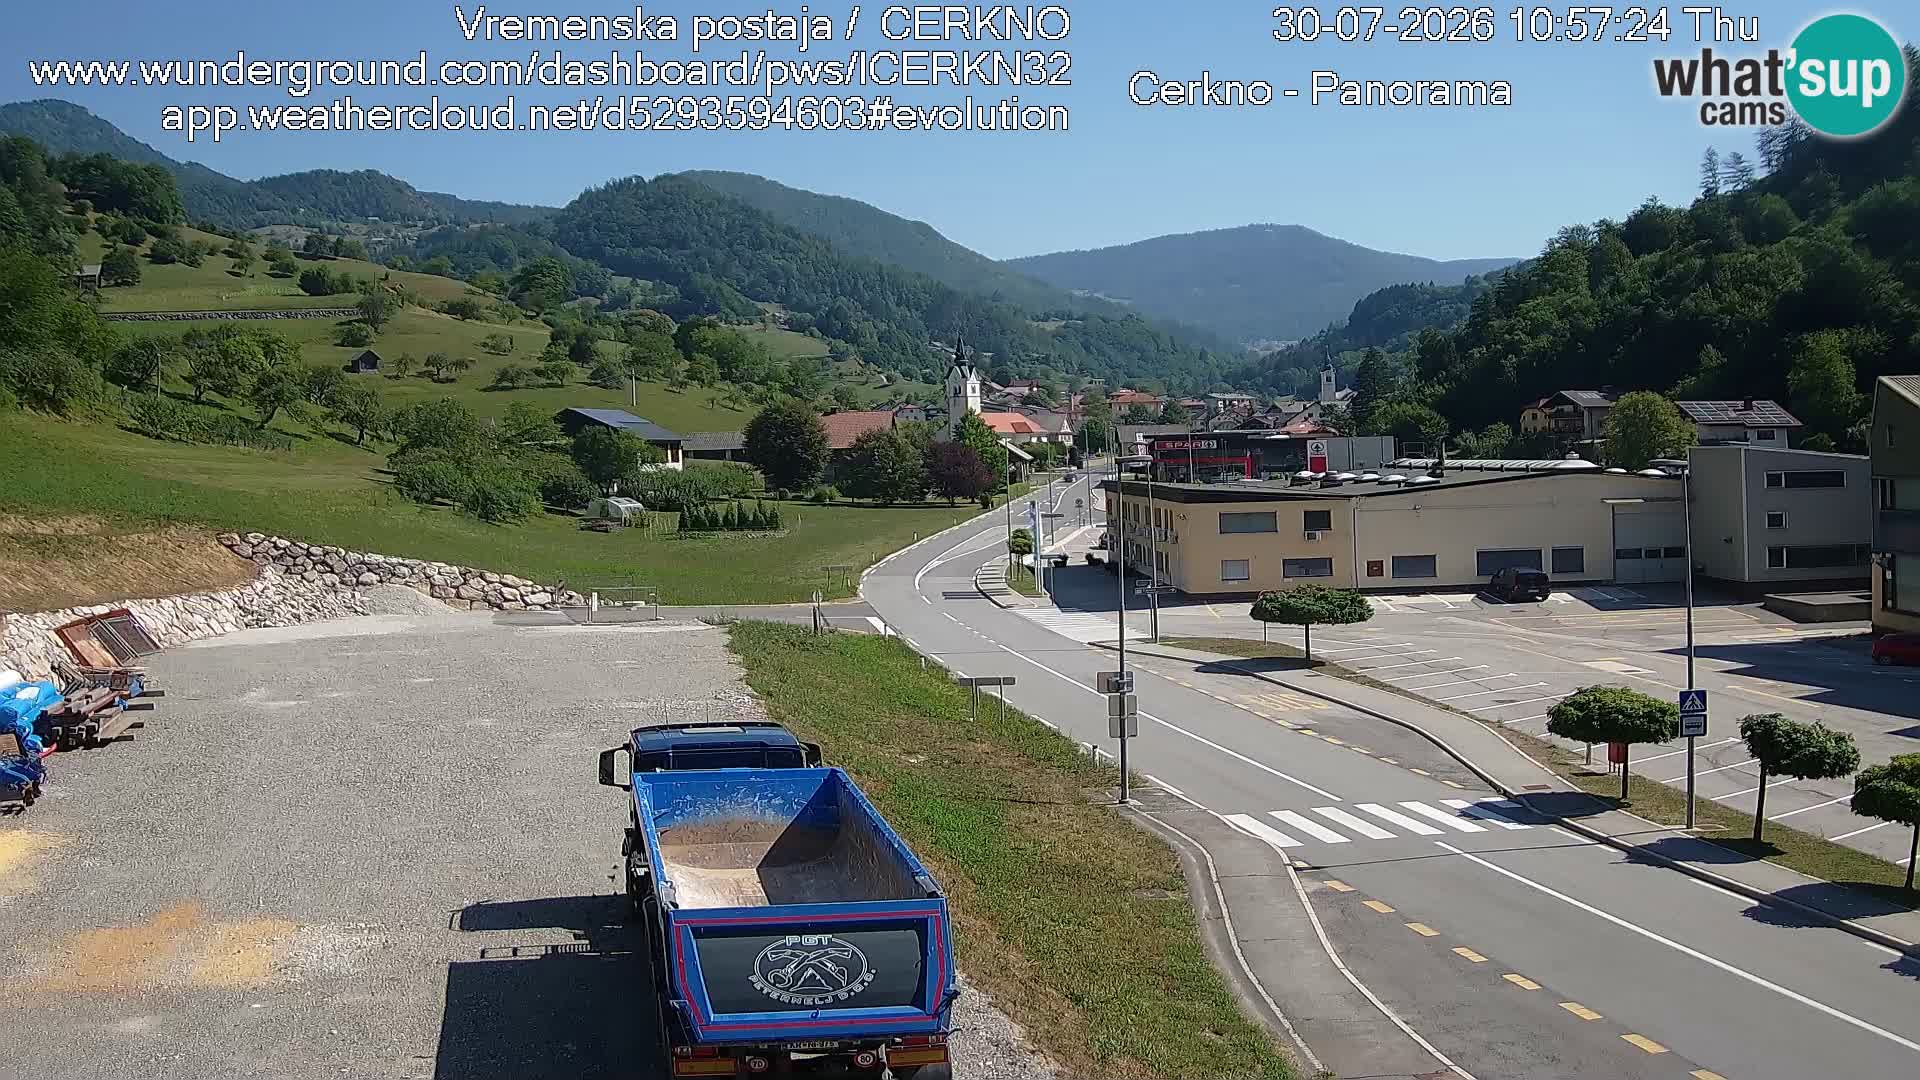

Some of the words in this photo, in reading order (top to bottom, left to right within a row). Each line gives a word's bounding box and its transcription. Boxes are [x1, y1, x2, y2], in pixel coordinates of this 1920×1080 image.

[1165, 441, 1201, 449] SPAR
[785, 934, 833, 947] PGT
[747, 974, 834, 1006] PETERNELJ
[860, 1055, 871, 1064] 80
